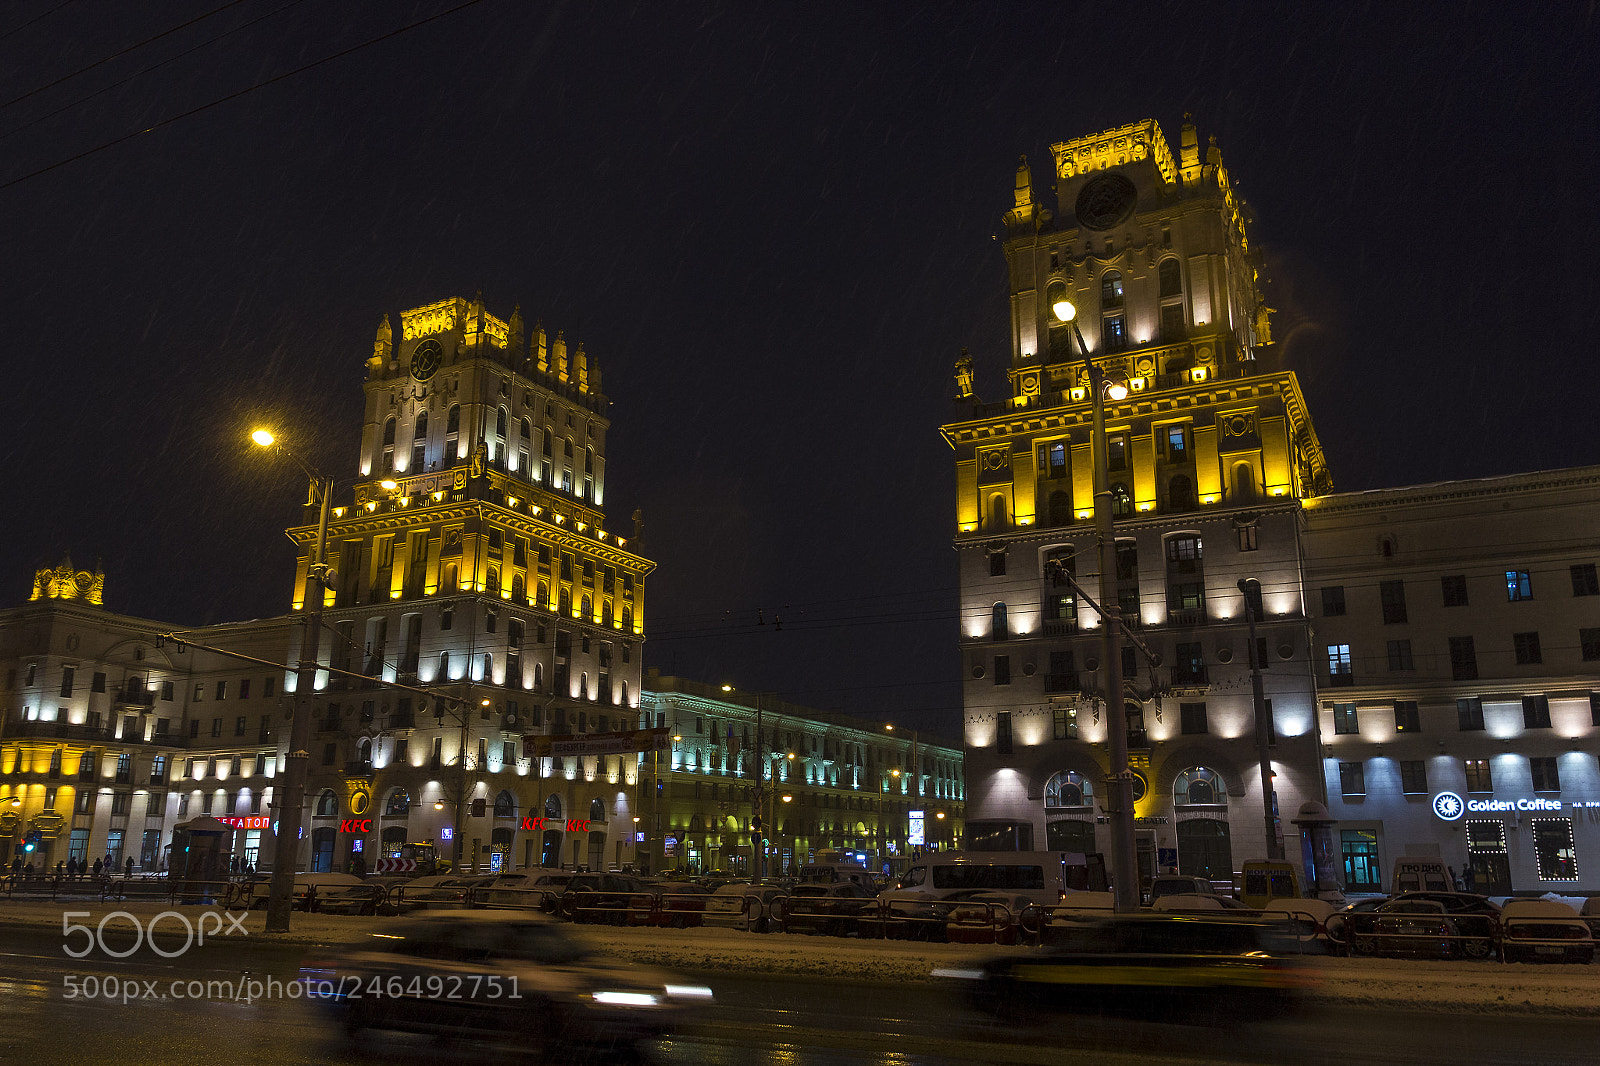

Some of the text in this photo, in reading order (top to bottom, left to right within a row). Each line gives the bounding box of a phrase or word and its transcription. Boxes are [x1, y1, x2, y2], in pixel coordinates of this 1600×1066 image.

[1467, 798, 1562, 812] Golden Coffee
[217, 818, 270, 828] ЕГАТОП
[339, 819, 372, 833] KFC
[520, 817, 549, 831] KFC
[566, 819, 591, 832] KFC
[1402, 864, 1442, 873] ГРОДНО
